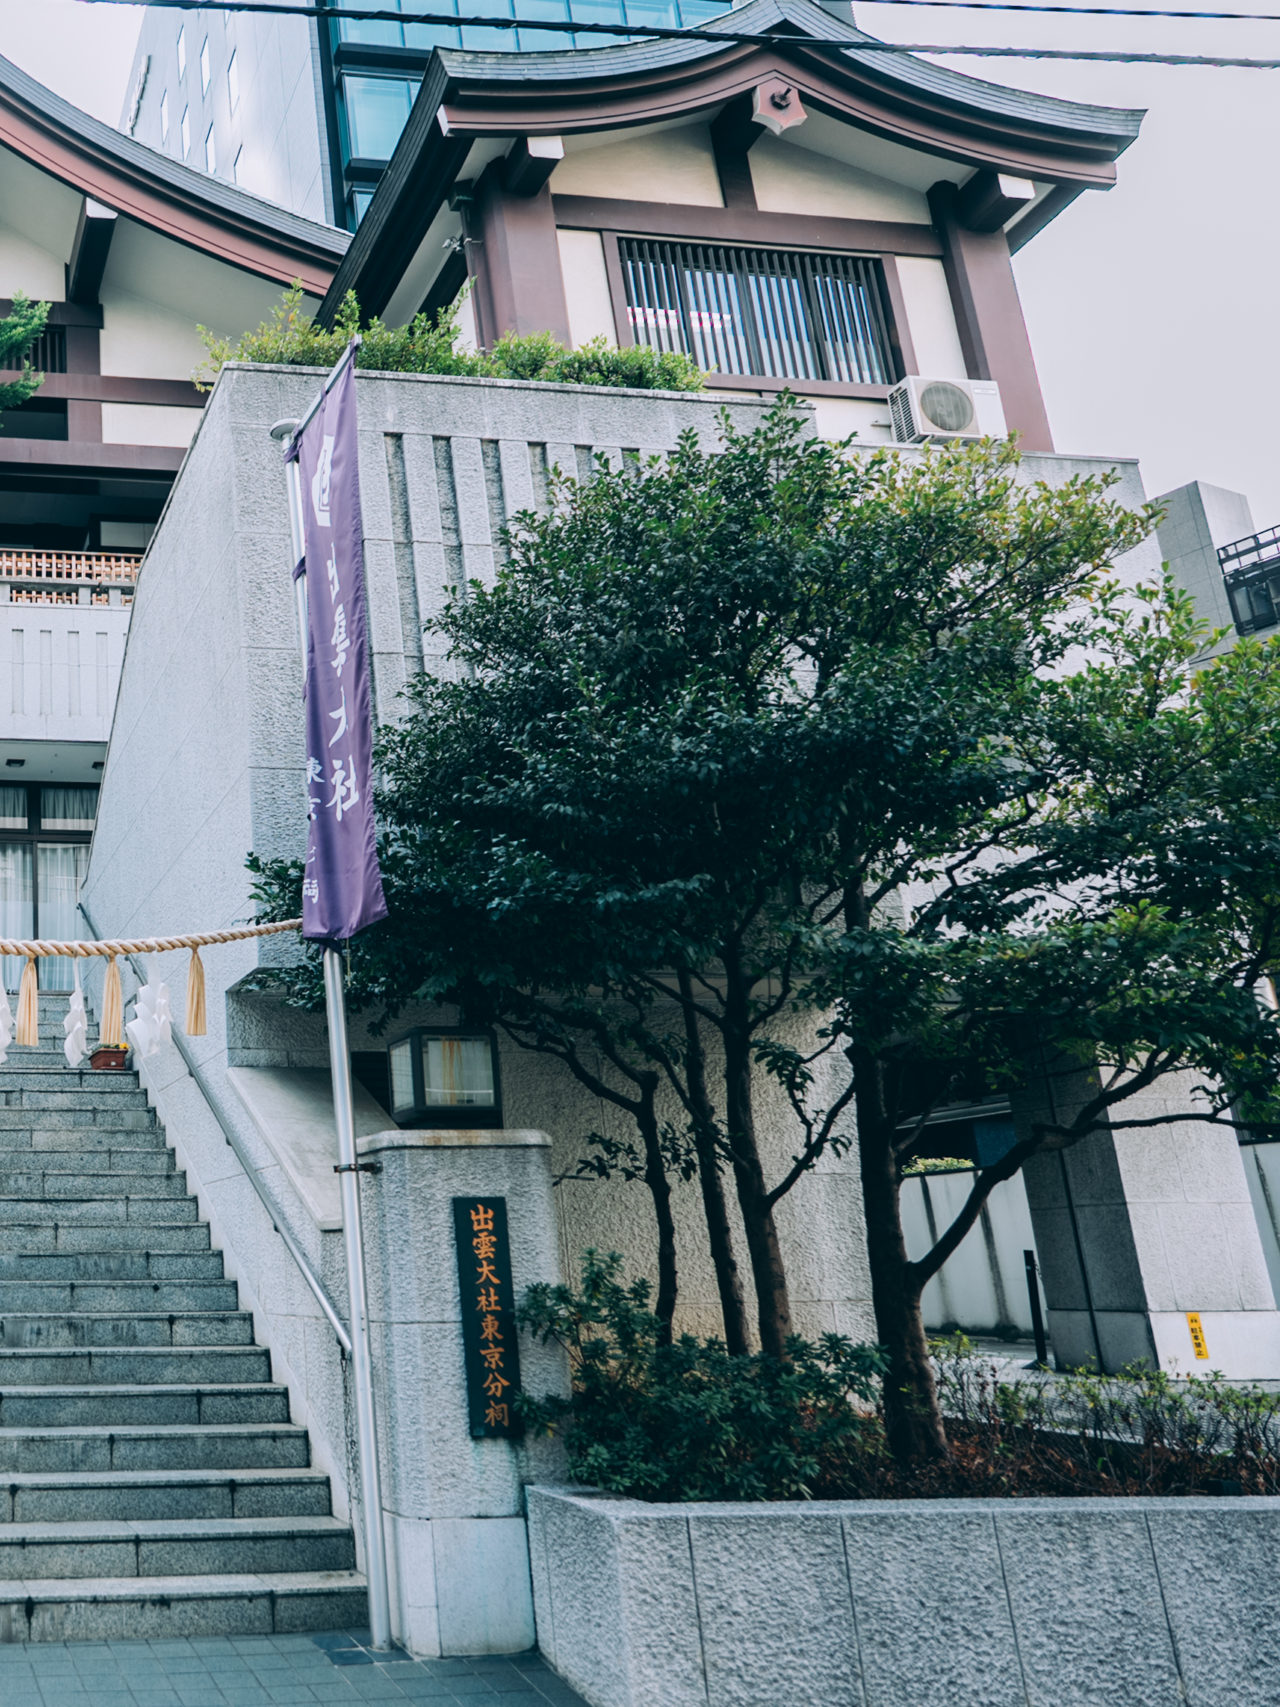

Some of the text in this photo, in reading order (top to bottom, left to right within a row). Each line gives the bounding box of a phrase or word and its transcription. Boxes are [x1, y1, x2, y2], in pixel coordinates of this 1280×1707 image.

[469, 1203, 511, 1428] 出雲大社東京分祠
